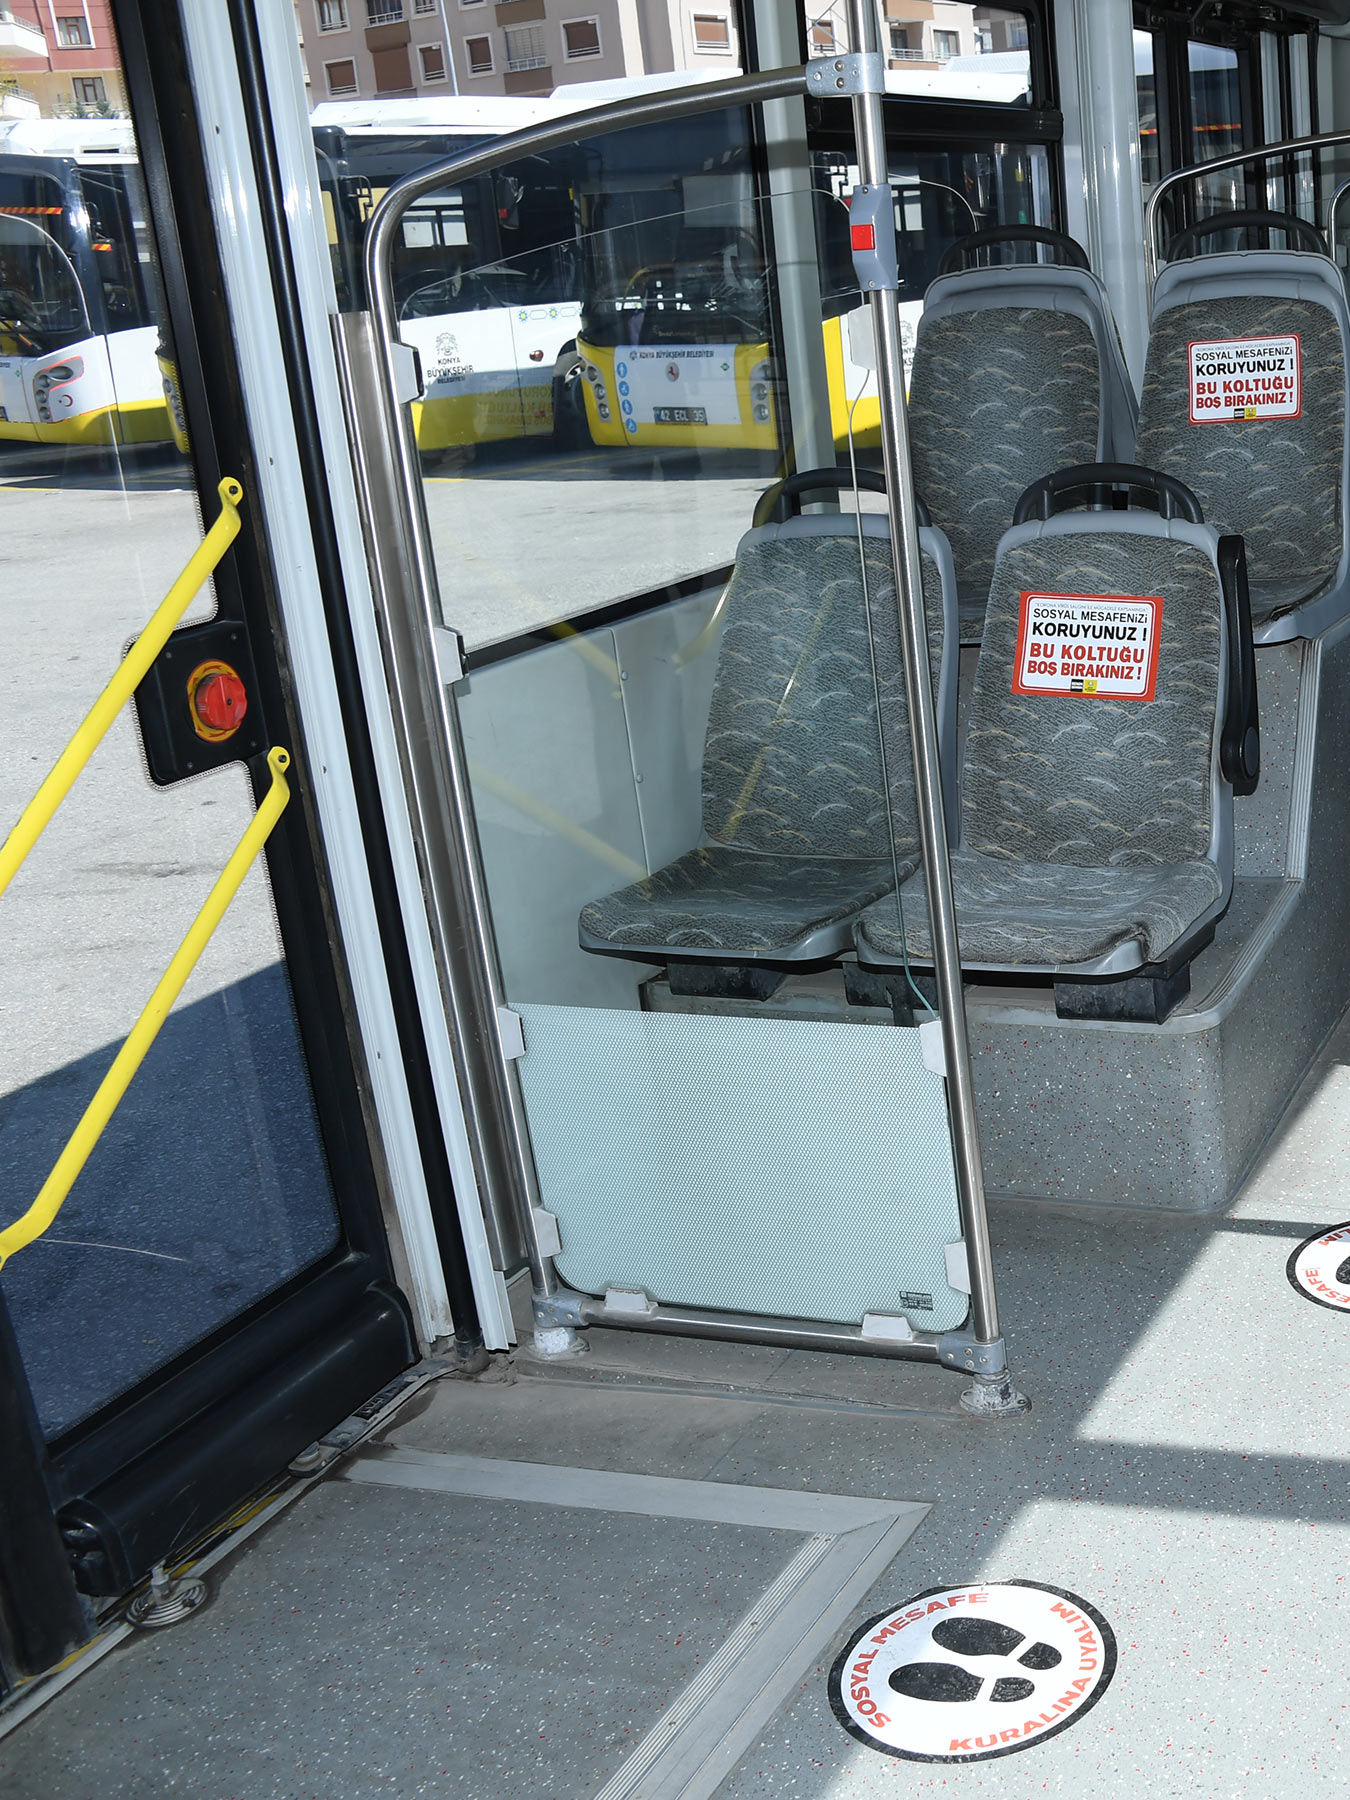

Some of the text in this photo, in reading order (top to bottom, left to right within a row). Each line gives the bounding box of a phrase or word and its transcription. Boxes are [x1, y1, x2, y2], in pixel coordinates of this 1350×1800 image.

[437, 357, 461, 365] KONYA
[1195, 351, 1233, 361] SOSYAL
[1196, 359, 1286, 376] KORUYUNUZ
[1196, 375, 1294, 395] BU KOLTUĞU
[1195, 396, 1221, 409] BOŞ
[1224, 392, 1287, 407] BIRAKINIZ
[1033, 608, 1078, 620] SOSYAL
[1032, 622, 1137, 641] KORUYUNUZ
[1030, 642, 1145, 663] BU KOLTUĞU
[1027, 660, 1058, 676] BOŞ
[1060, 662, 1135, 680] BIRAKINIZ
[850, 1593, 989, 1728] SOSYAL MESAFE
[949, 1602, 1098, 1751] KURALINA UYALIM
